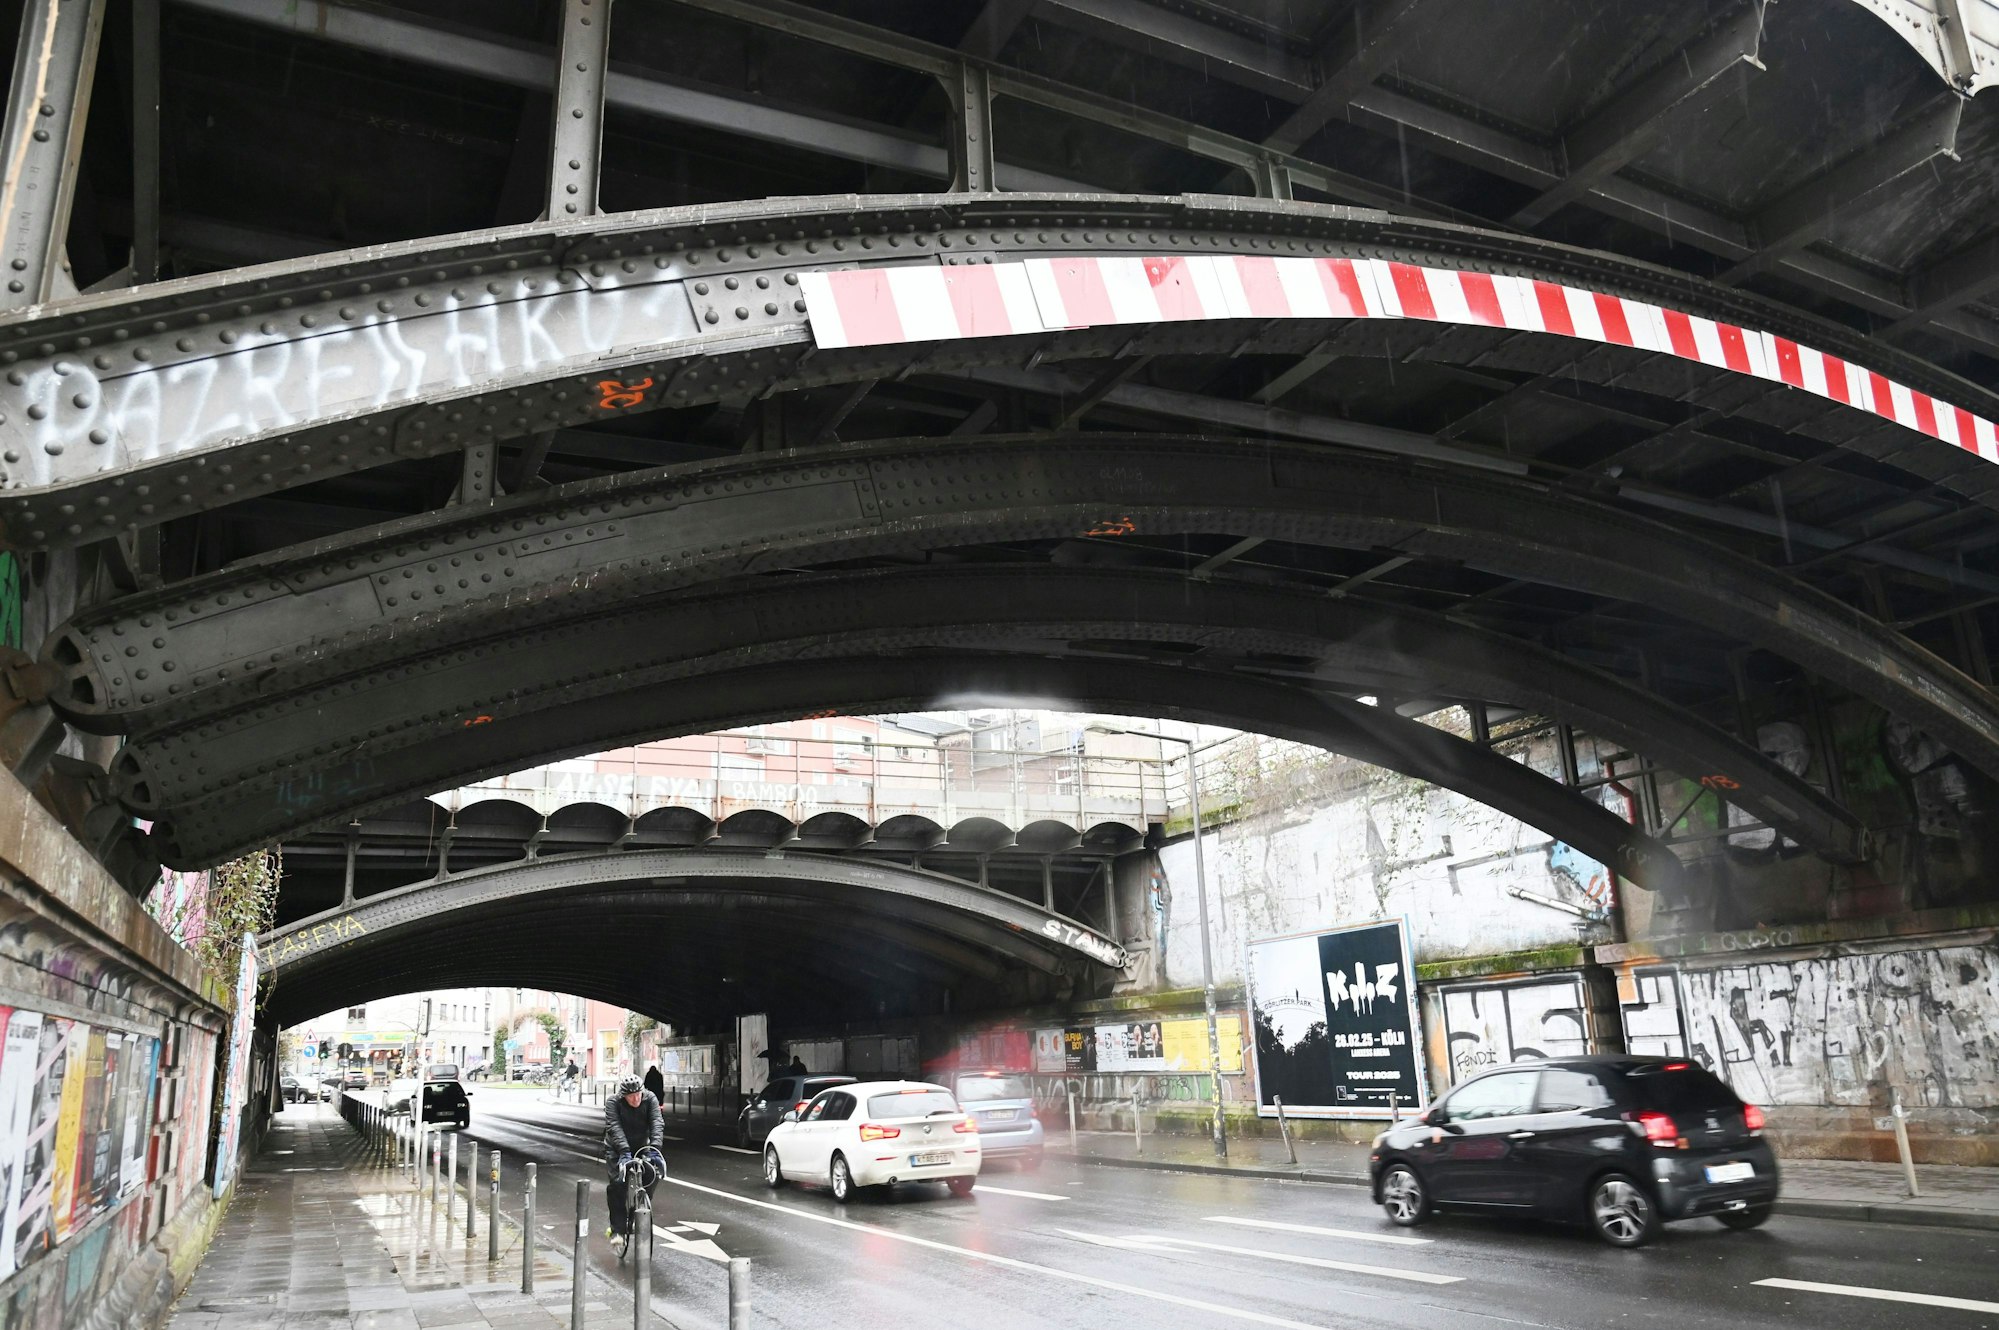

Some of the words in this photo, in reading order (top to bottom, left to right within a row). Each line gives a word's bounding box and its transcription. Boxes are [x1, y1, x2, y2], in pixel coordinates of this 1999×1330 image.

[1381, 1029, 1406, 1046] KÖLN
[1071, 1041, 1083, 1050] BOY
[1346, 1071, 1374, 1080] TOUR
